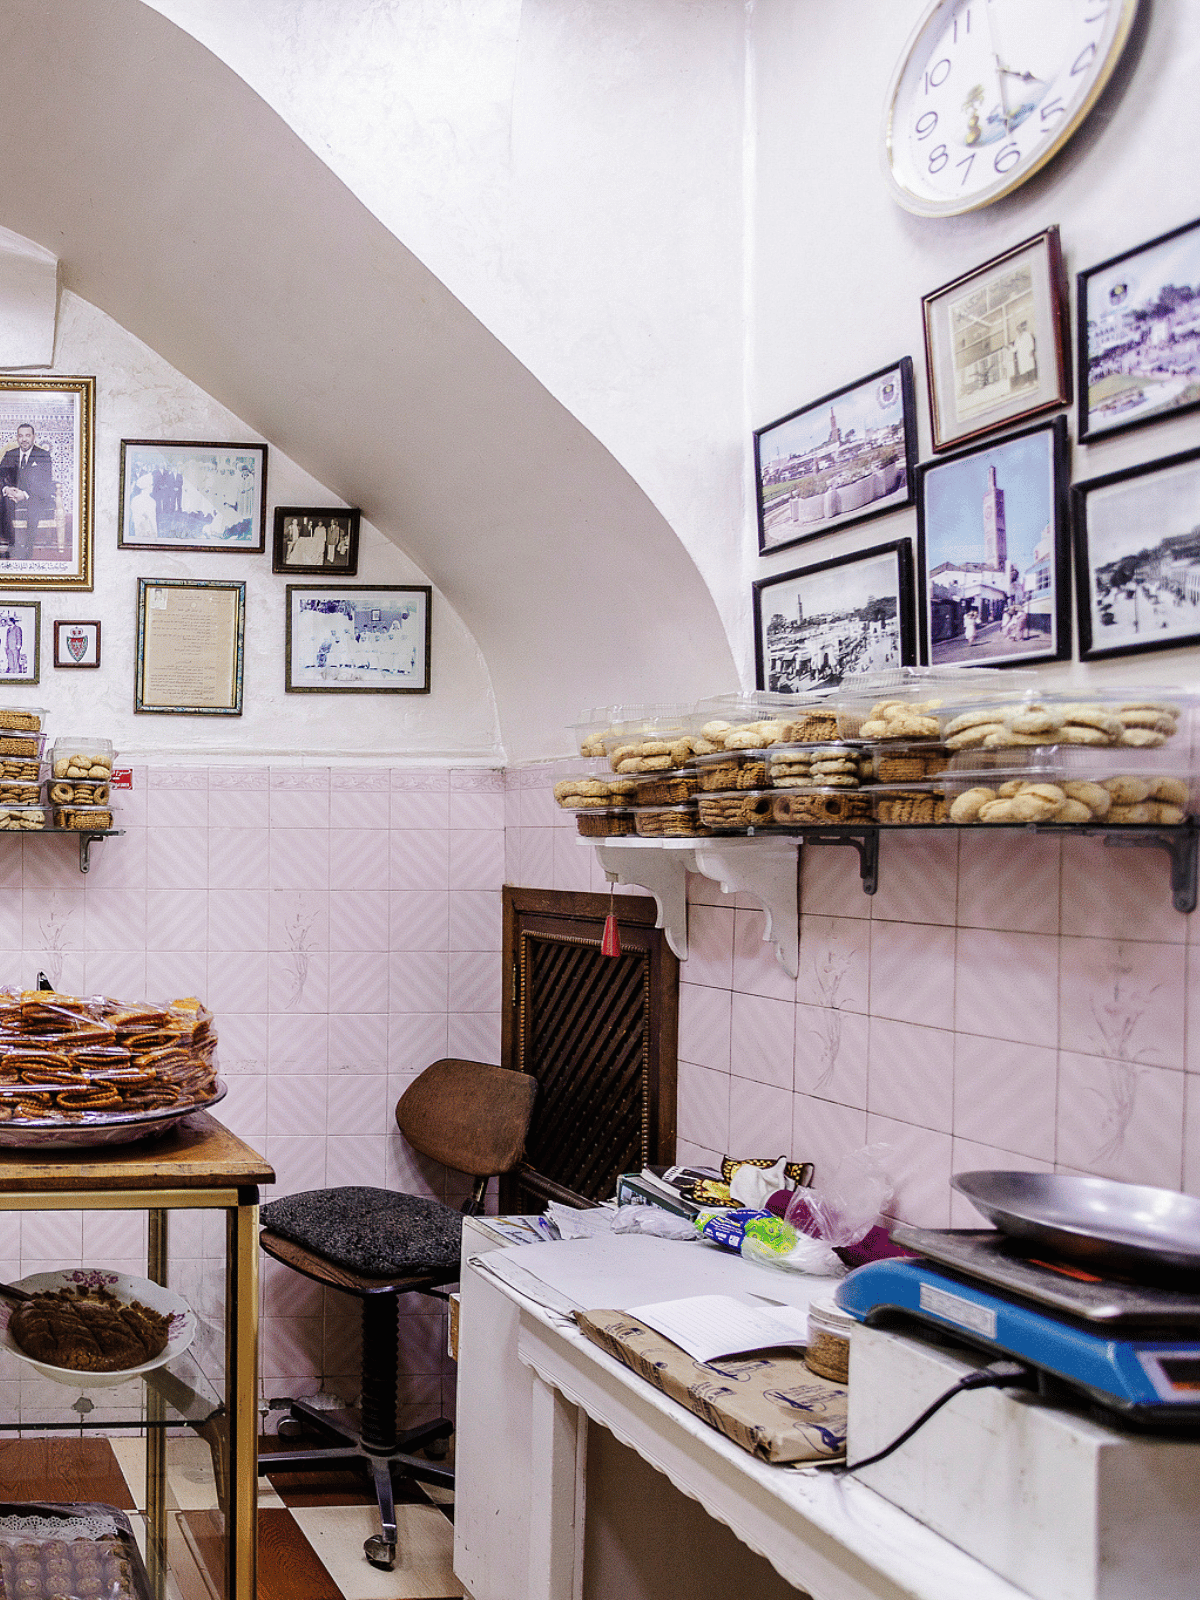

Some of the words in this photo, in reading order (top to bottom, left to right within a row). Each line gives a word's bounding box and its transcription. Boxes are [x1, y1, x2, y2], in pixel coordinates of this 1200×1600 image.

[953, 8, 971, 44] 11
[924, 58, 951, 96] 10
[915, 110, 938, 141] 9
[927, 143, 948, 175] 8
[955, 152, 976, 186] 7
[993, 142, 1021, 174] 6
